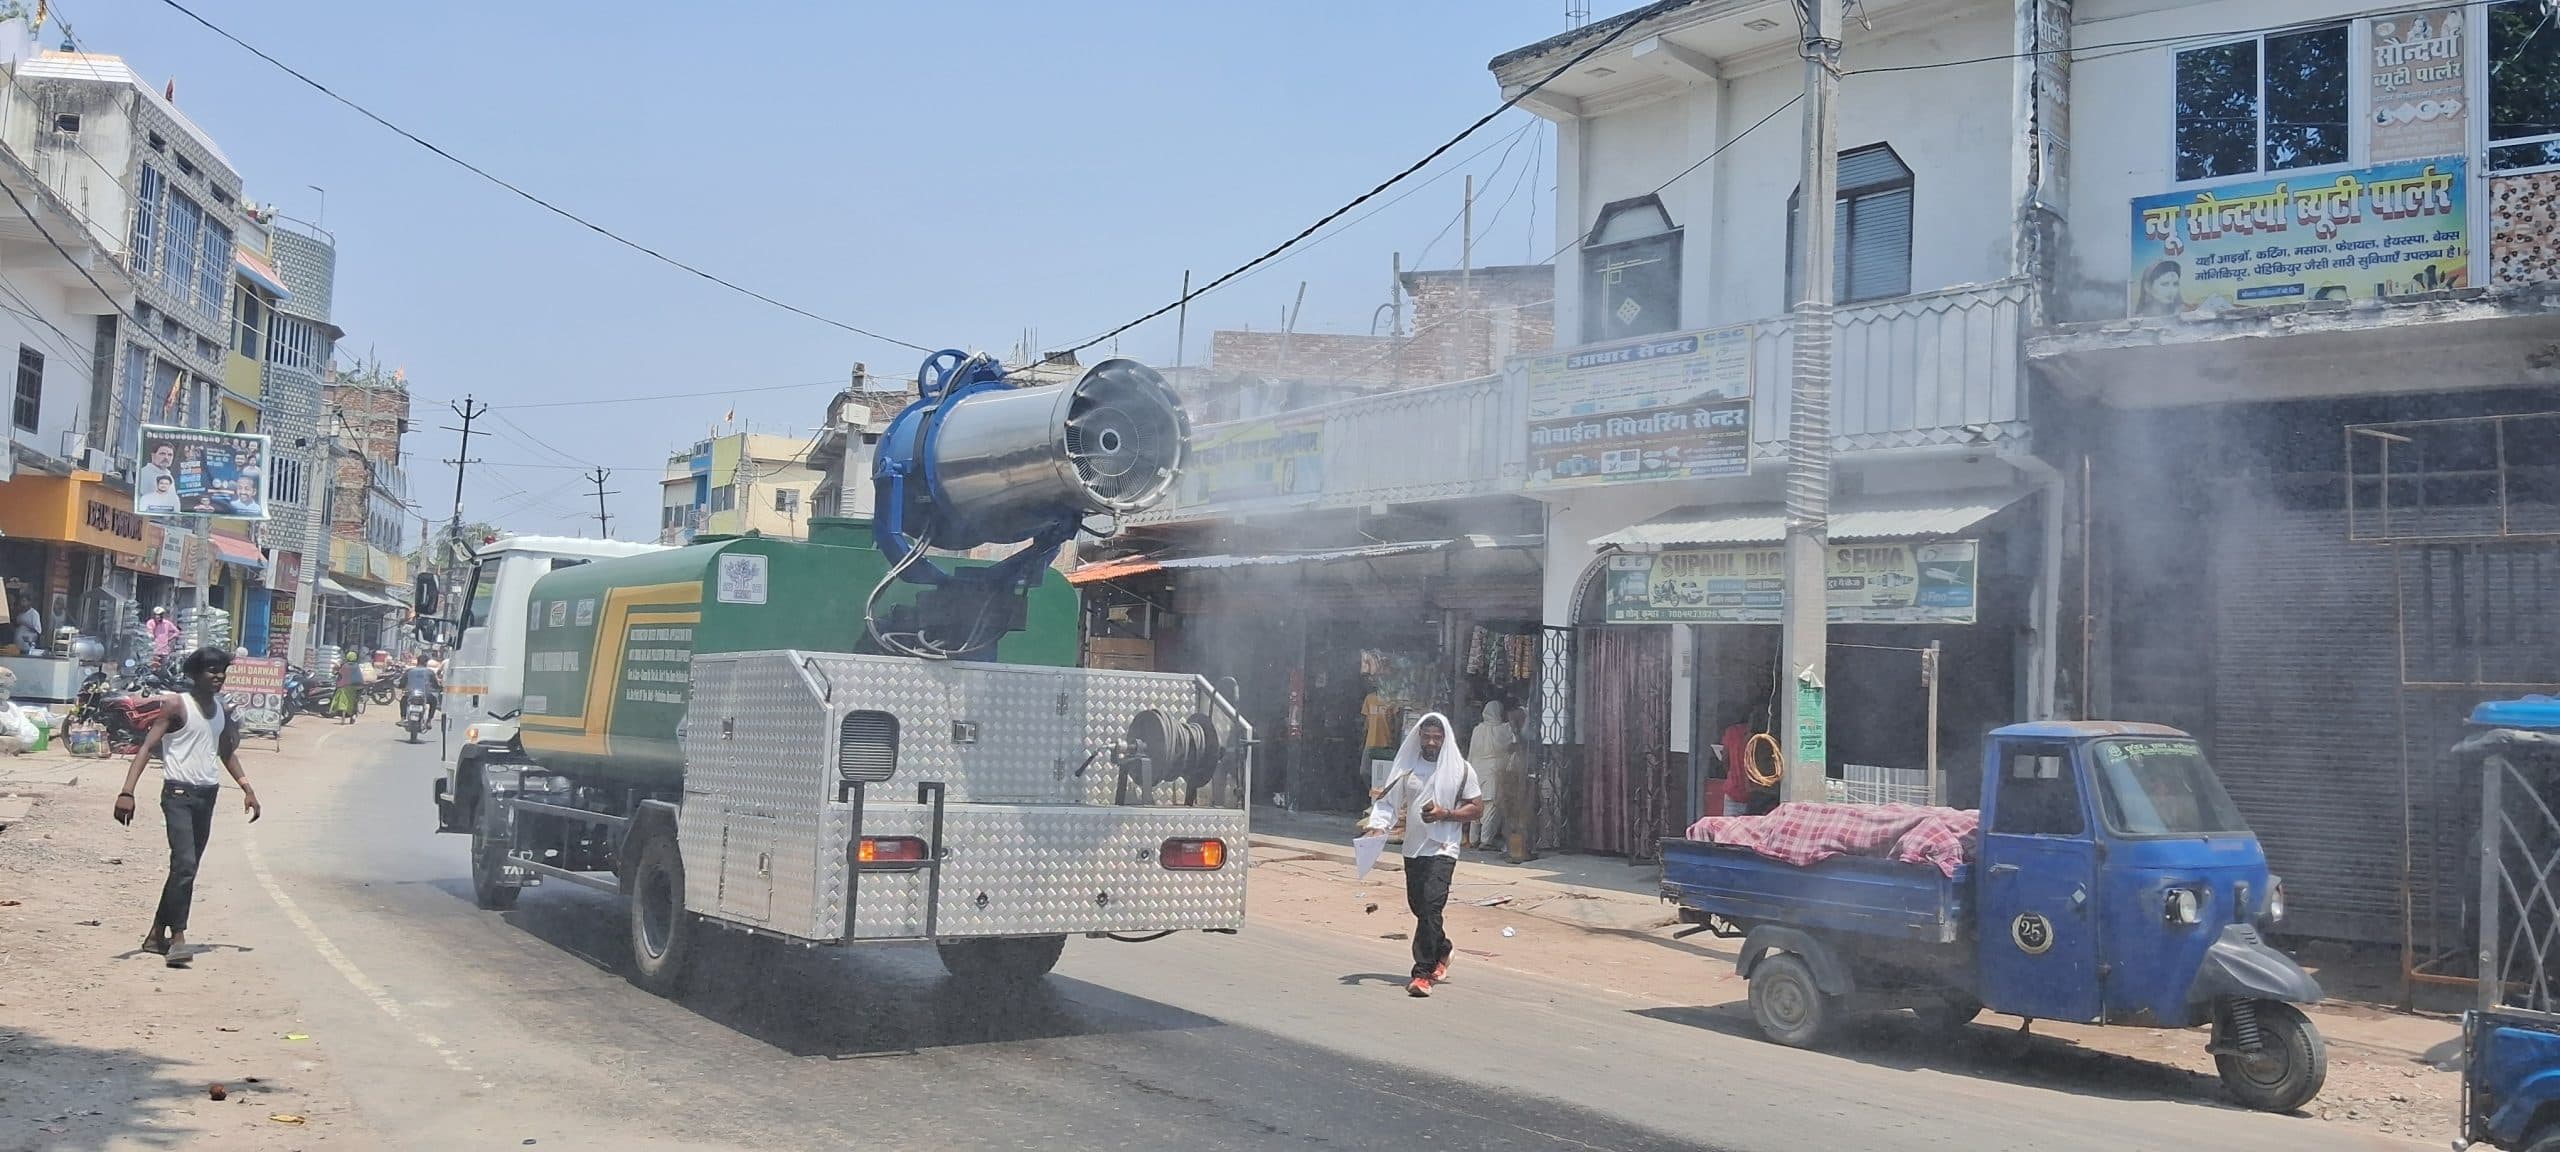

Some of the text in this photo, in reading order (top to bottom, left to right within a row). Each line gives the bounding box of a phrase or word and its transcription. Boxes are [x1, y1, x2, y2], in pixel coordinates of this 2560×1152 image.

[2374, 27, 2462, 68] सौन्दर्या
[2373, 60, 2462, 92] ब्यूटी पार्लर
[2143, 164, 2454, 256] न्यू सौन्दर्या ब्यूटी पार्लर
[2195, 253, 2216, 267] यहाँ
[2305, 257, 2330, 271] जैसी
[2332, 255, 2355, 269] सारी
[2403, 248, 2443, 262] उपलब्ध
[1568, 349, 1632, 369] आधार
[1661, 553, 1738, 578] SUPAUL
[1836, 547, 1905, 573] SEWA
[2020, 920, 2041, 942] 25
